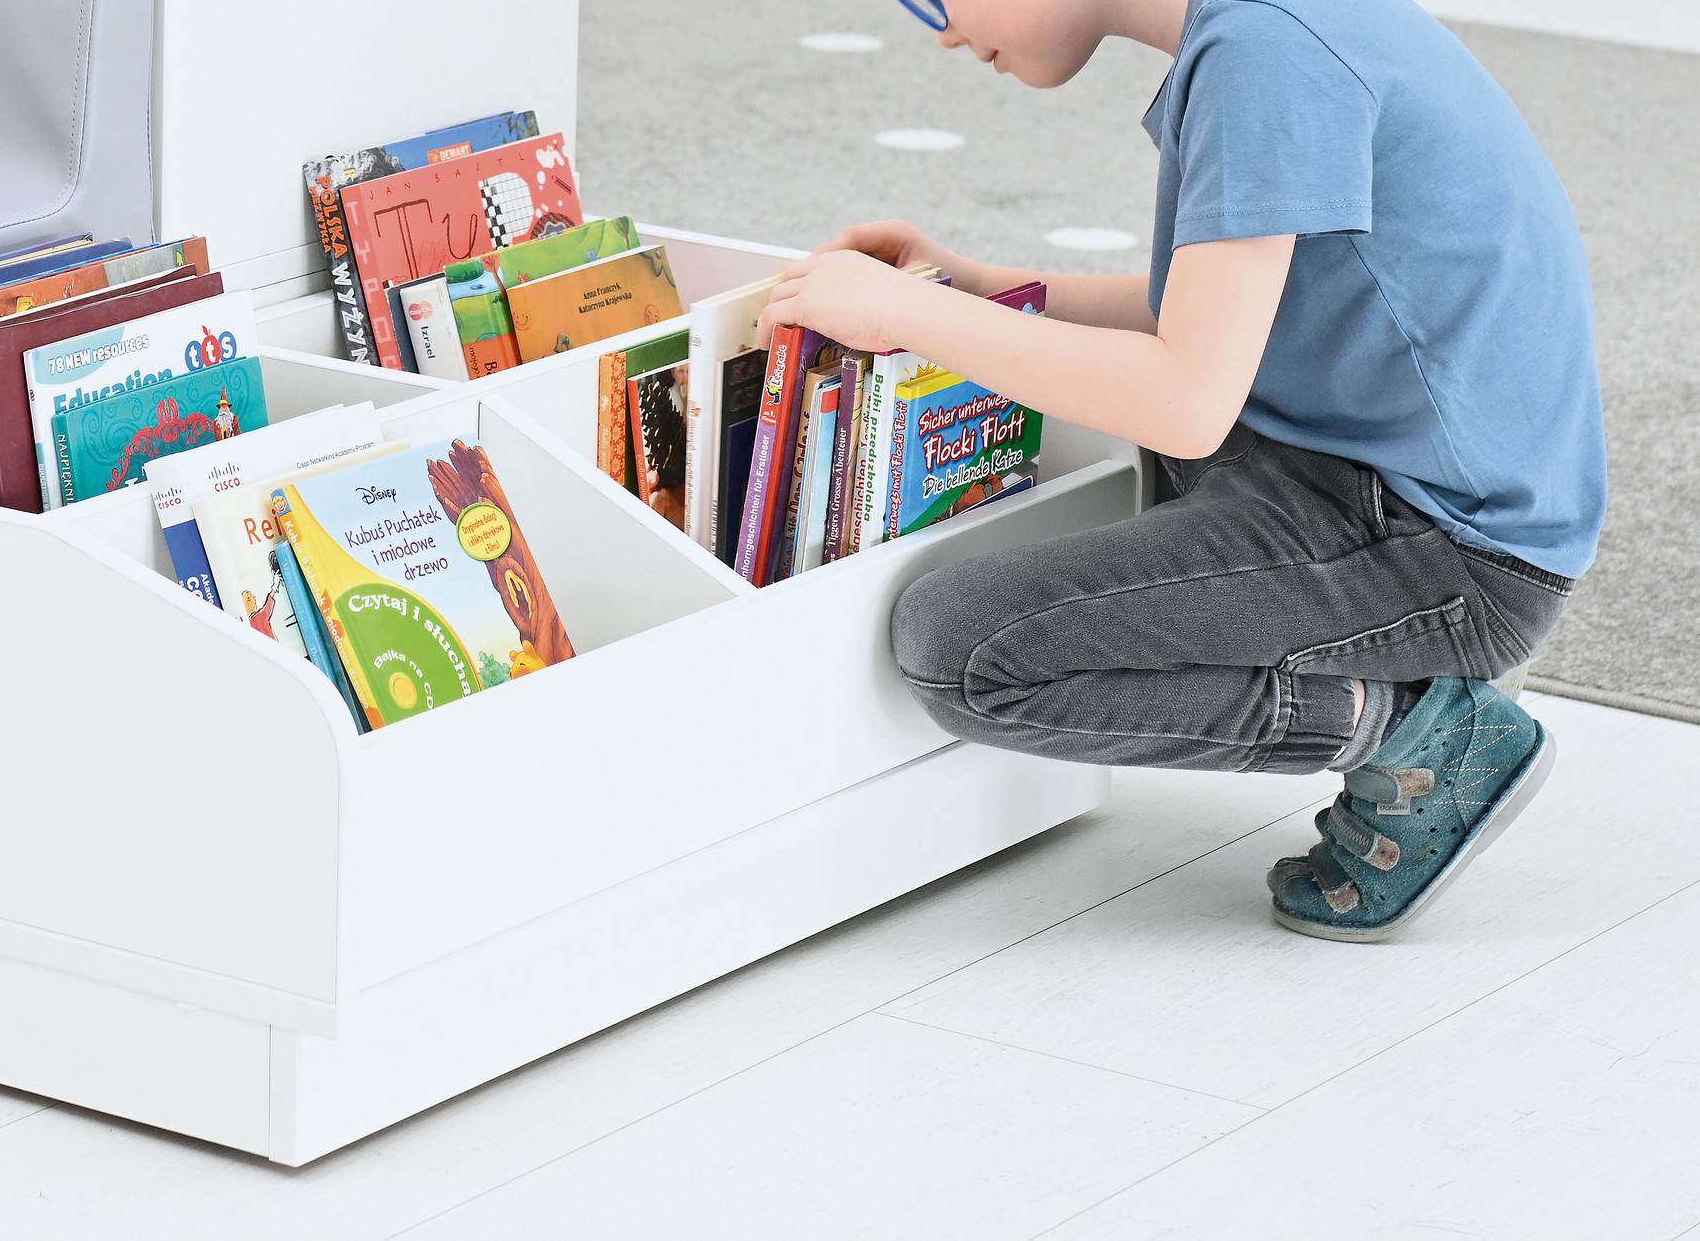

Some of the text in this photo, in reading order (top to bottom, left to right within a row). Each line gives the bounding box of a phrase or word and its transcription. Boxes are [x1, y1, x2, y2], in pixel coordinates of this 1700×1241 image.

[439, 143, 471, 161] DEMART
[369, 181, 412, 201] JAN
[315, 174, 348, 259] POLSKA
[48, 334, 150, 376] 78 NEW resources
[185, 330, 238, 372] tts
[420, 325, 437, 359] Izrael
[468, 346, 480, 375] mojego
[770, 344, 787, 388] Leserabe
[874, 373, 884, 415] Bajki
[894, 401, 908, 432] Flott
[919, 407, 957, 437] Sicher
[756, 434, 770, 473] Erstleser
[836, 427, 848, 473] Abenteuer
[890, 434, 905, 467] Flocki
[923, 408, 1027, 470] Flocki Flott
[213, 476, 242, 493] CISCO
[754, 474, 766, 493] für
[863, 417, 878, 523] przedszkolaka
[889, 466, 902, 491] mit
[922, 447, 1024, 499] Die bellende Katze
[157, 497, 182, 510] CISCO
[831, 475, 844, 511] Grosses
[344, 504, 442, 549] Kubuś Puchatek
[826, 513, 840, 548] Tiggers
[371, 535, 437, 566] i miodowe
[403, 557, 449, 581] drzewo
[348, 593, 472, 699] Czytaj i słucha
[373, 649, 434, 709] Bajka na CD
